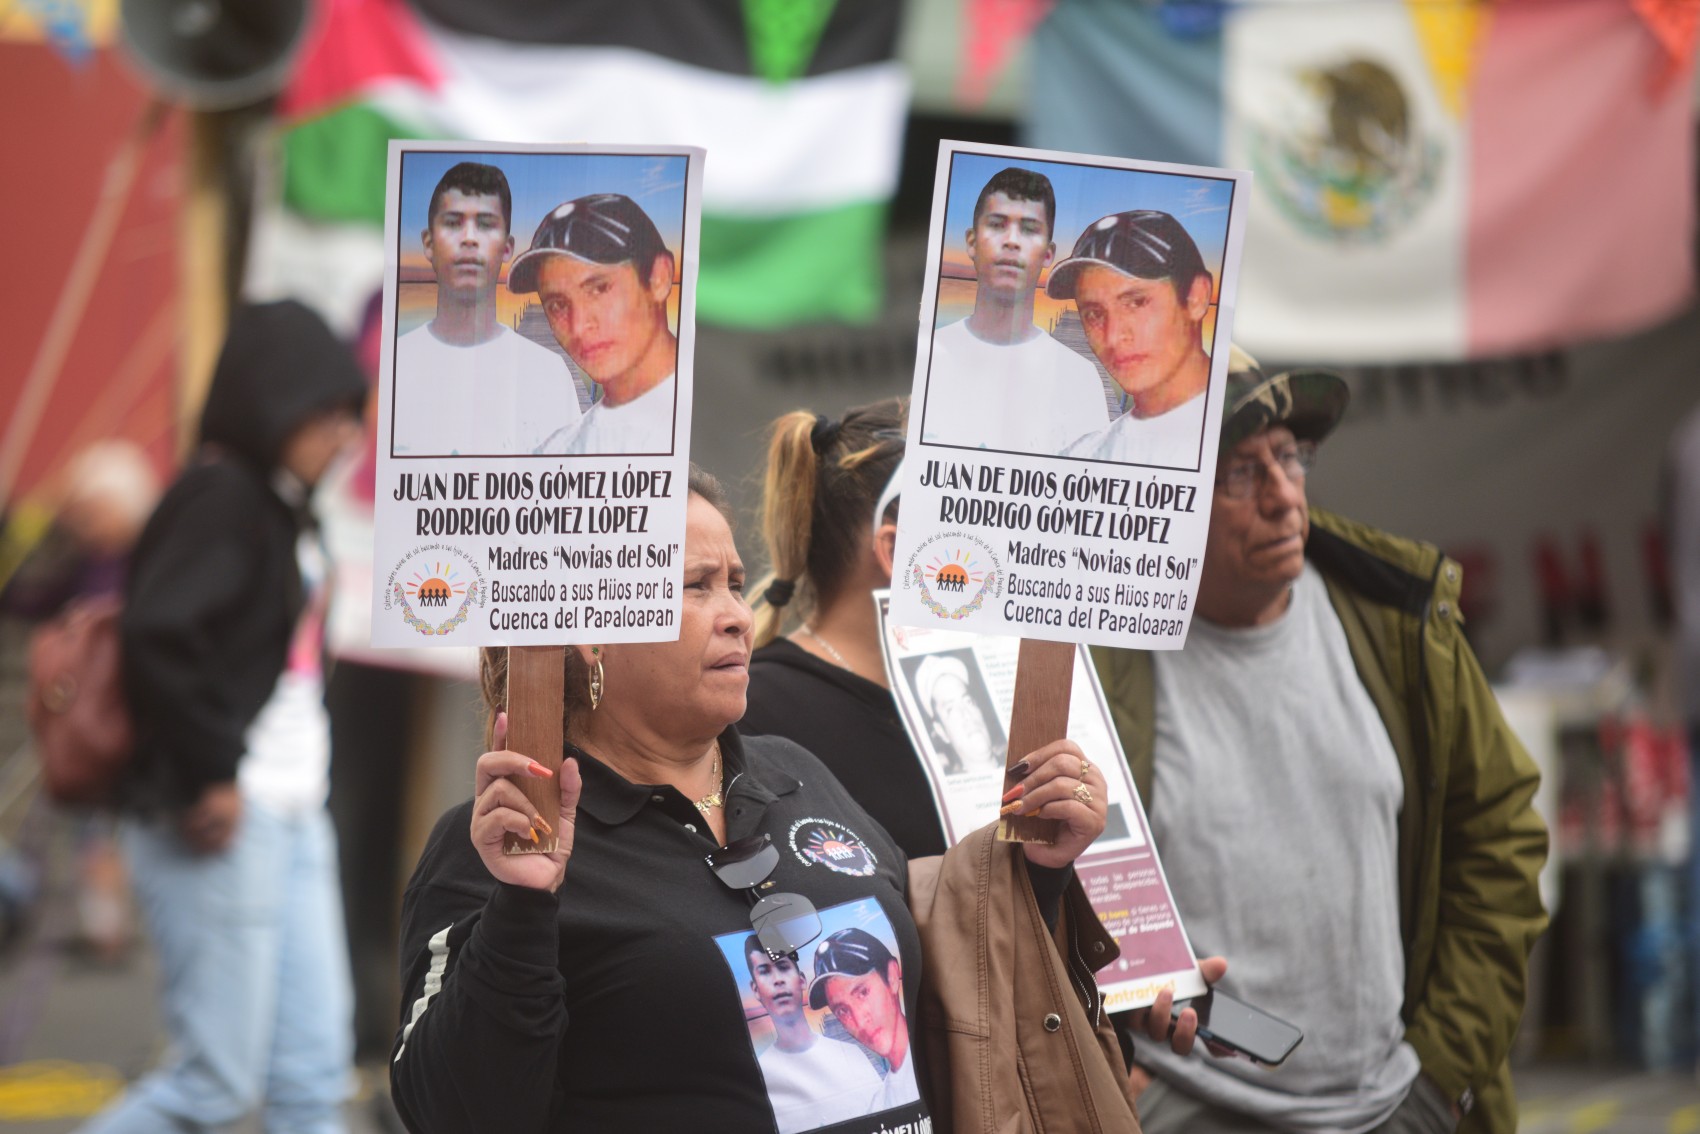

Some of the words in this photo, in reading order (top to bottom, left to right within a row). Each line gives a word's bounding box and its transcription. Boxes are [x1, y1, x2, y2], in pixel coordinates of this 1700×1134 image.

[394, 474, 447, 501] JUAN
[454, 473, 479, 500] DE
[486, 472, 533, 500] DIOS
[540, 465, 606, 499] GÓMEZ
[612, 464, 671, 498] LÓPEZ
[920, 460, 973, 490] JUAN
[978, 466, 1005, 493] DE
[1010, 469, 1057, 499] DIOS
[1063, 469, 1130, 506] GÓMEZ
[1135, 476, 1196, 512] LÓPEZ
[417, 508, 510, 536] RODRIGO
[516, 500, 582, 535] GÓMEZ
[589, 499, 648, 534] LÓPEZ
[940, 496, 1031, 530] RODRIGO
[1037, 500, 1104, 537] GÓMEZ
[1109, 507, 1170, 544] LÓPEZ
[470, 562, 482, 577] Cuenca
[489, 547, 548, 570] Madres
[554, 544, 612, 569] “Novias
[617, 545, 641, 568] del
[646, 544, 678, 568] Sol”
[1008, 541, 1066, 568] Madres
[1072, 548, 1130, 574] “Novias
[1136, 554, 1161, 577] del
[1166, 556, 1197, 580] Sol”
[492, 580, 555, 602] Buscando
[560, 584, 566, 601] a
[572, 584, 593, 601] sus
[599, 579, 631, 600] Hijos
[637, 583, 658, 599] por
[663, 578, 672, 598] la
[1008, 574, 1070, 600] Buscando
[1076, 585, 1082, 601] a
[1088, 586, 1109, 604] sus
[1115, 584, 1148, 607] Hijos
[1154, 592, 1174, 609] por
[1178, 590, 1187, 610] la
[490, 608, 548, 630] Cuenca
[555, 607, 577, 628] del
[585, 606, 673, 628] Papaloapan
[1004, 600, 1061, 626] Cuenca
[1068, 606, 1092, 628] del
[1099, 609, 1183, 636] Papaloapan
